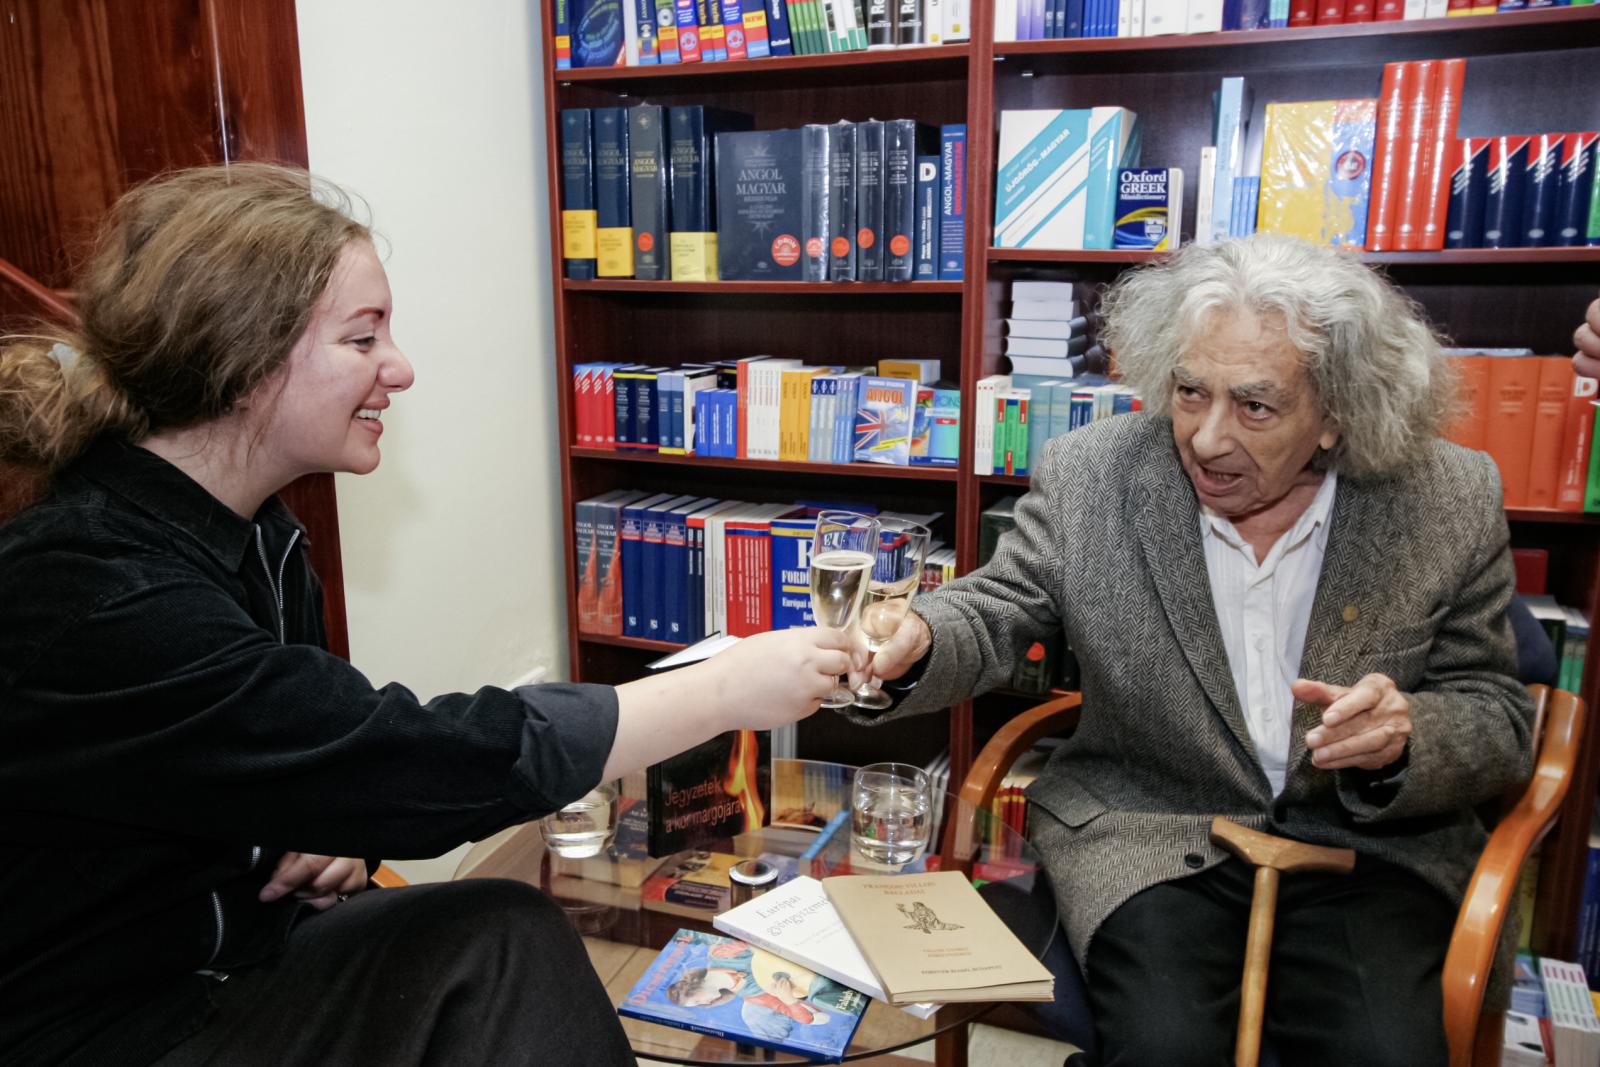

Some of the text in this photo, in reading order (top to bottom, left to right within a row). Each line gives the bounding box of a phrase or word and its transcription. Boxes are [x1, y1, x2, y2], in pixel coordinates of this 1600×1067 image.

[738, 168, 783, 182] ANGOL
[919, 162, 937, 181] D
[1120, 170, 1167, 184] Oxford
[736, 183, 787, 195] MAGYAR
[1120, 183, 1166, 194] GREEK
[664, 776, 722, 807] Jegyzetek
